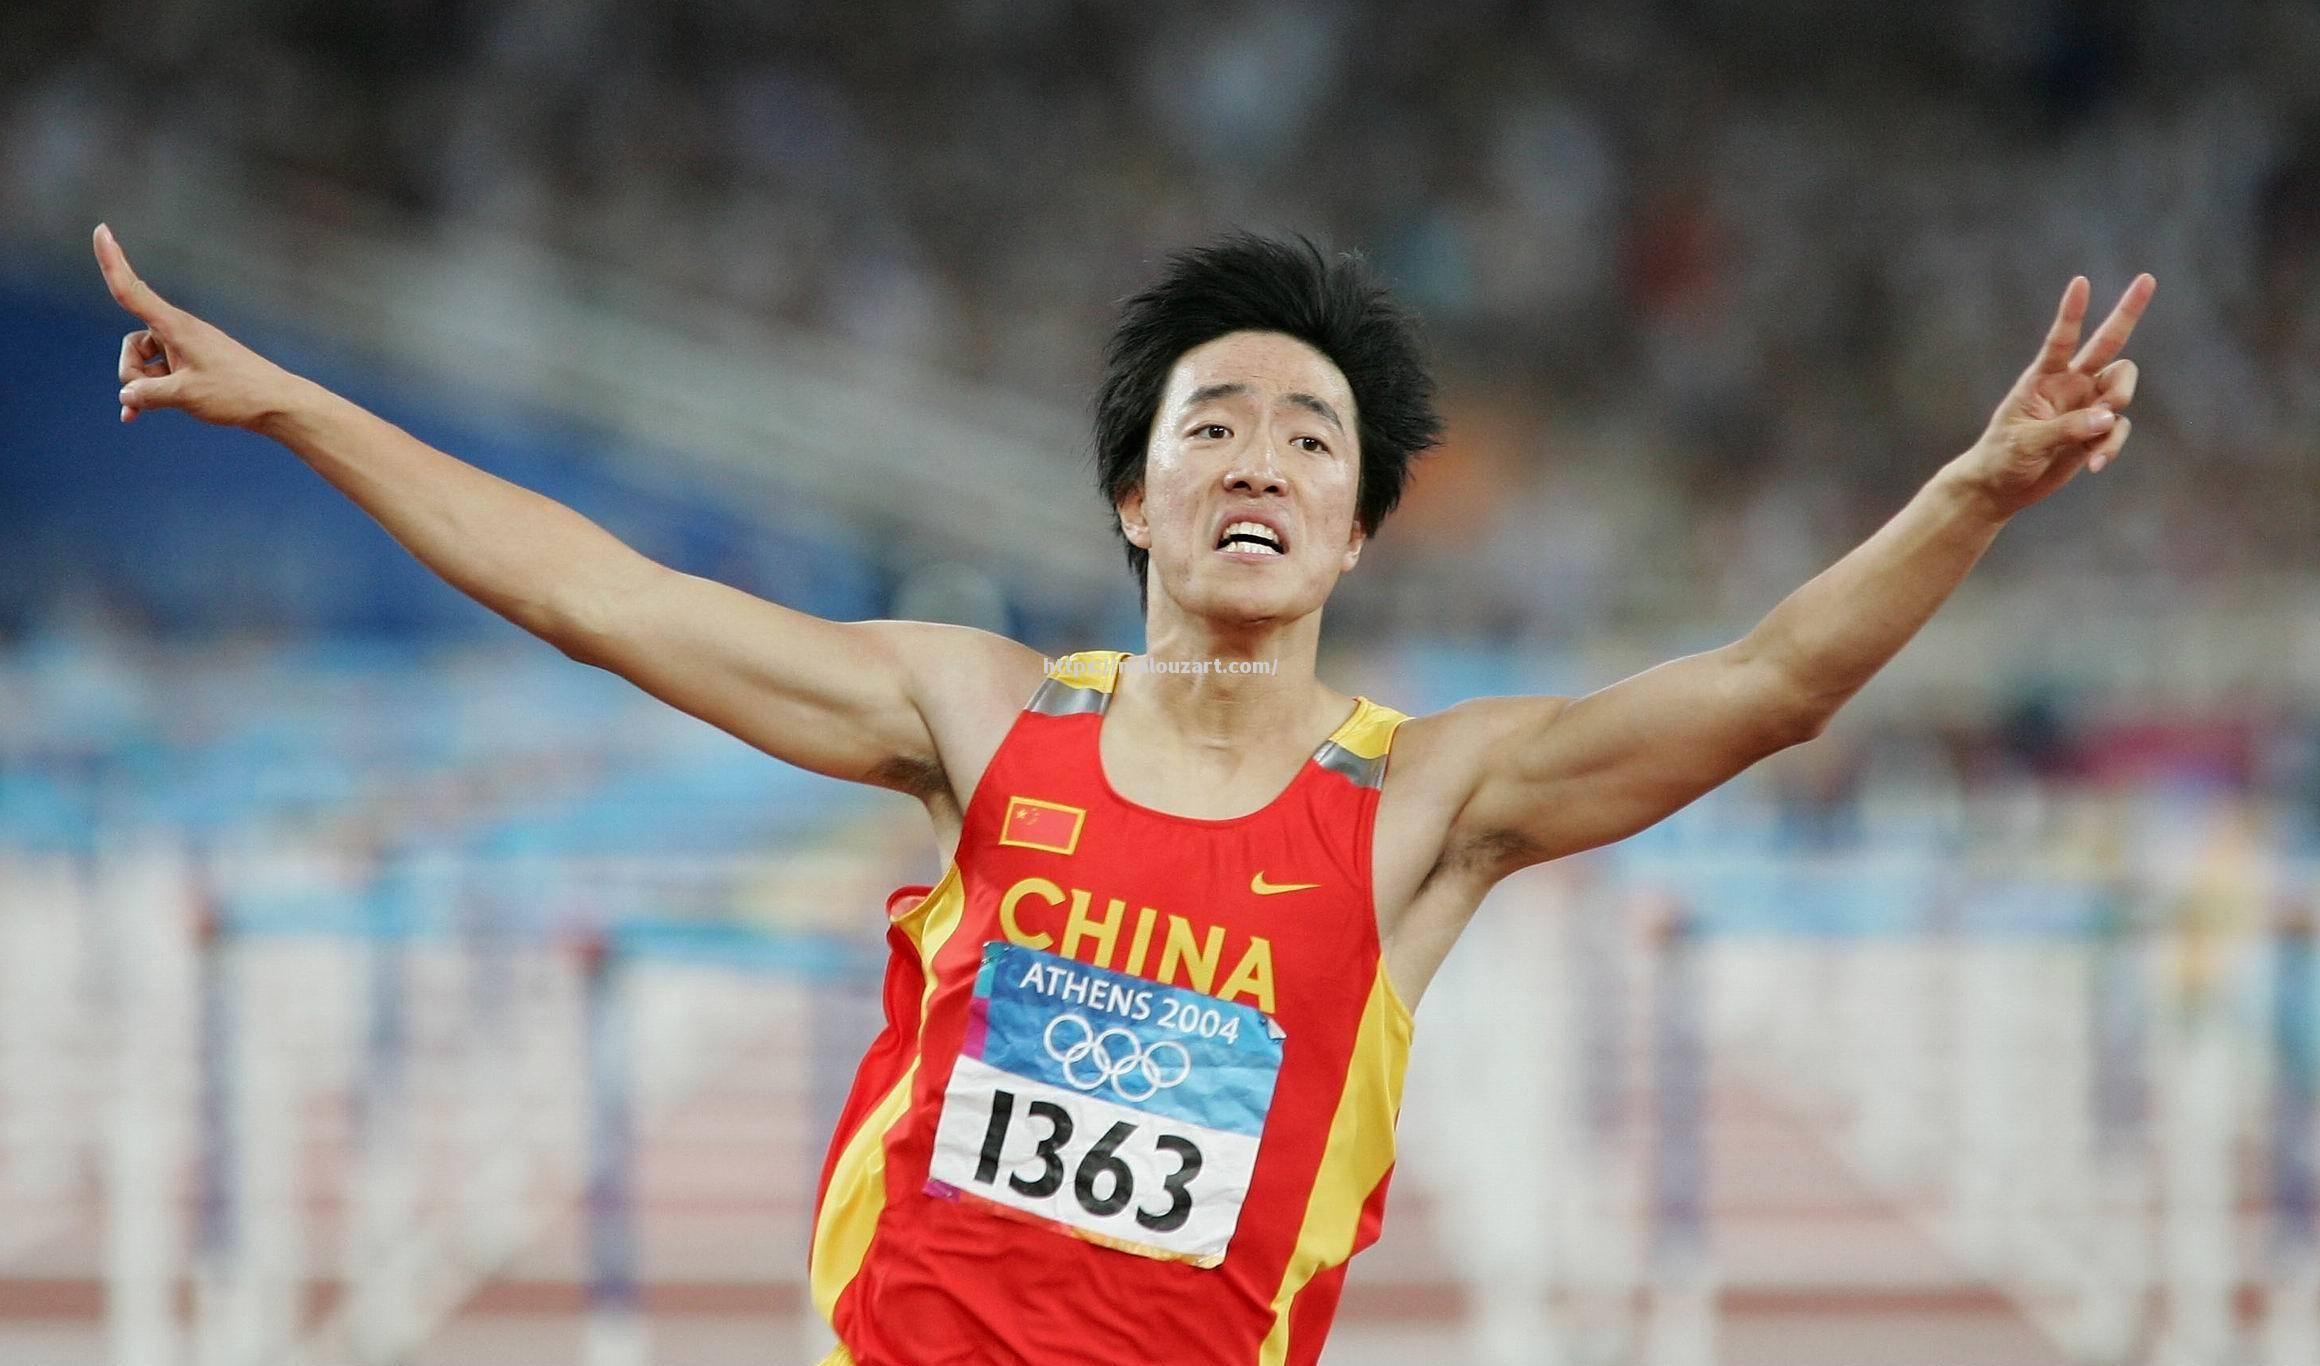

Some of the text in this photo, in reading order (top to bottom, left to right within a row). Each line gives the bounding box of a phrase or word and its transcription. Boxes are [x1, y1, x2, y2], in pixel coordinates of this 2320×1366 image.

[1000, 877, 1276, 1014] CHINA
[1020, 961, 1241, 1044] ATHENS 2004
[974, 1089, 1203, 1233] 1363
